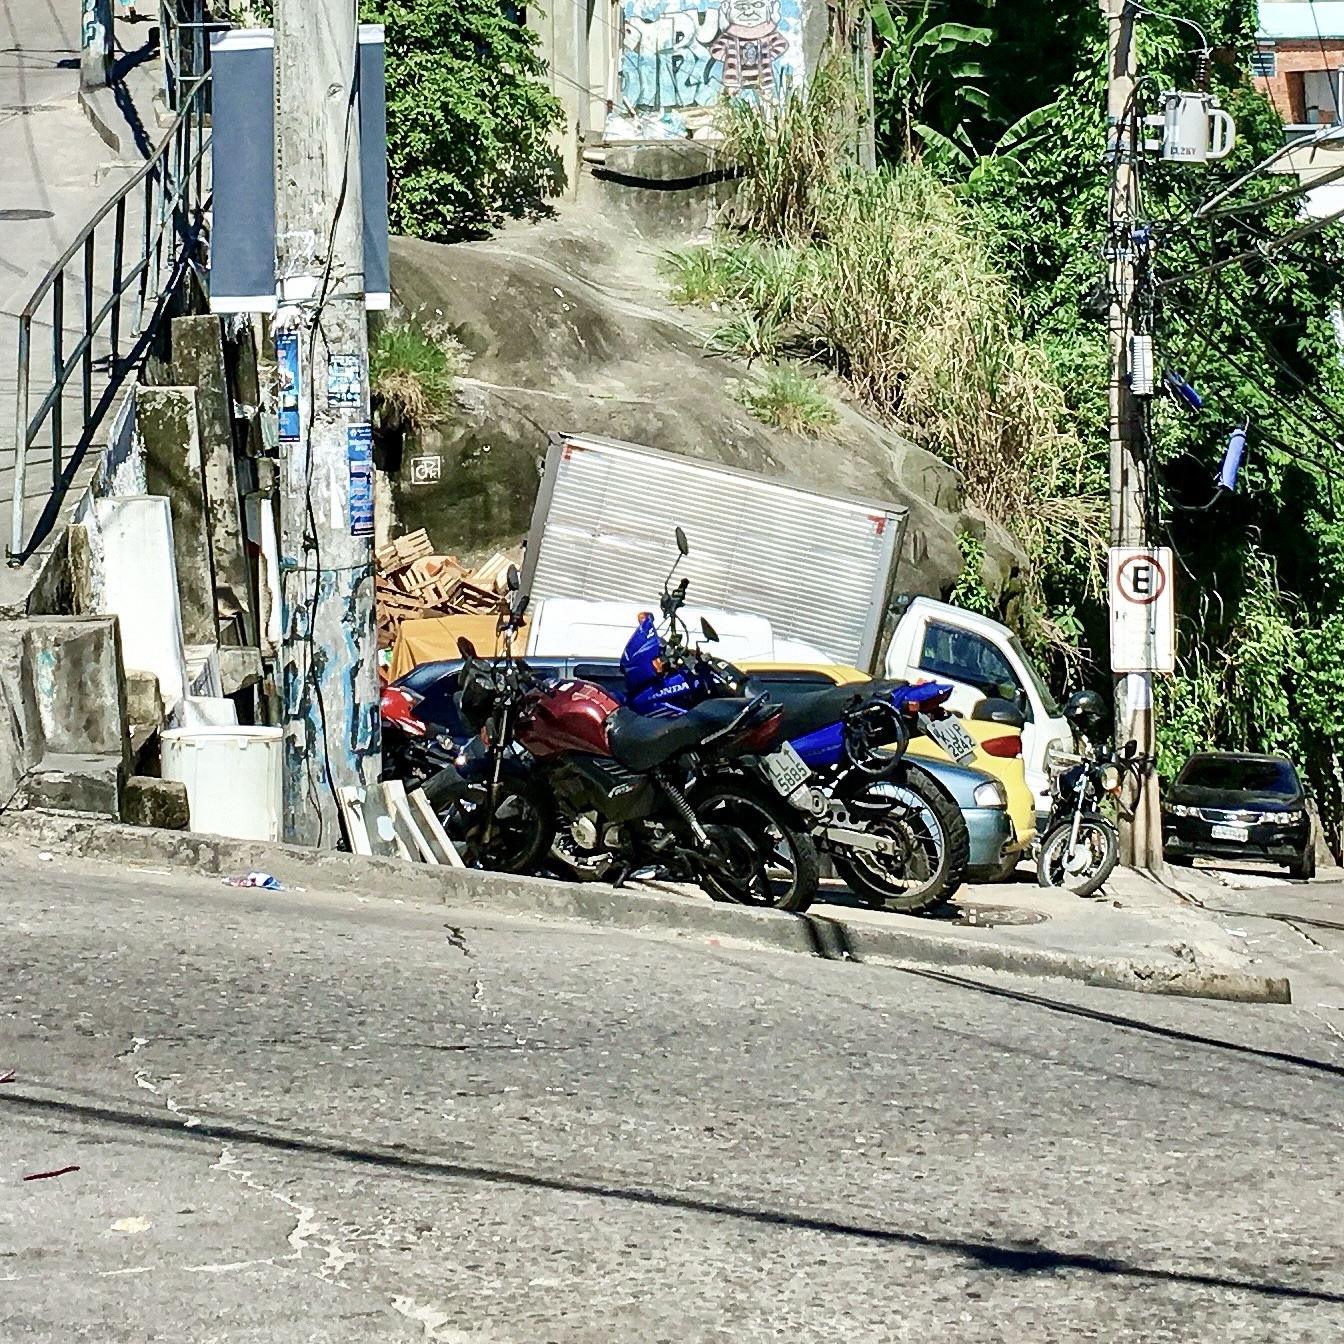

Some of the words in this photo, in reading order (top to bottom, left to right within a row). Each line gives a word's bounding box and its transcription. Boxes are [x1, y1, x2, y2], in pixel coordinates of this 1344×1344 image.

[1133, 566, 1150, 593] E
[947, 735, 976, 757] 2842
[778, 762, 807, 792] 5885
